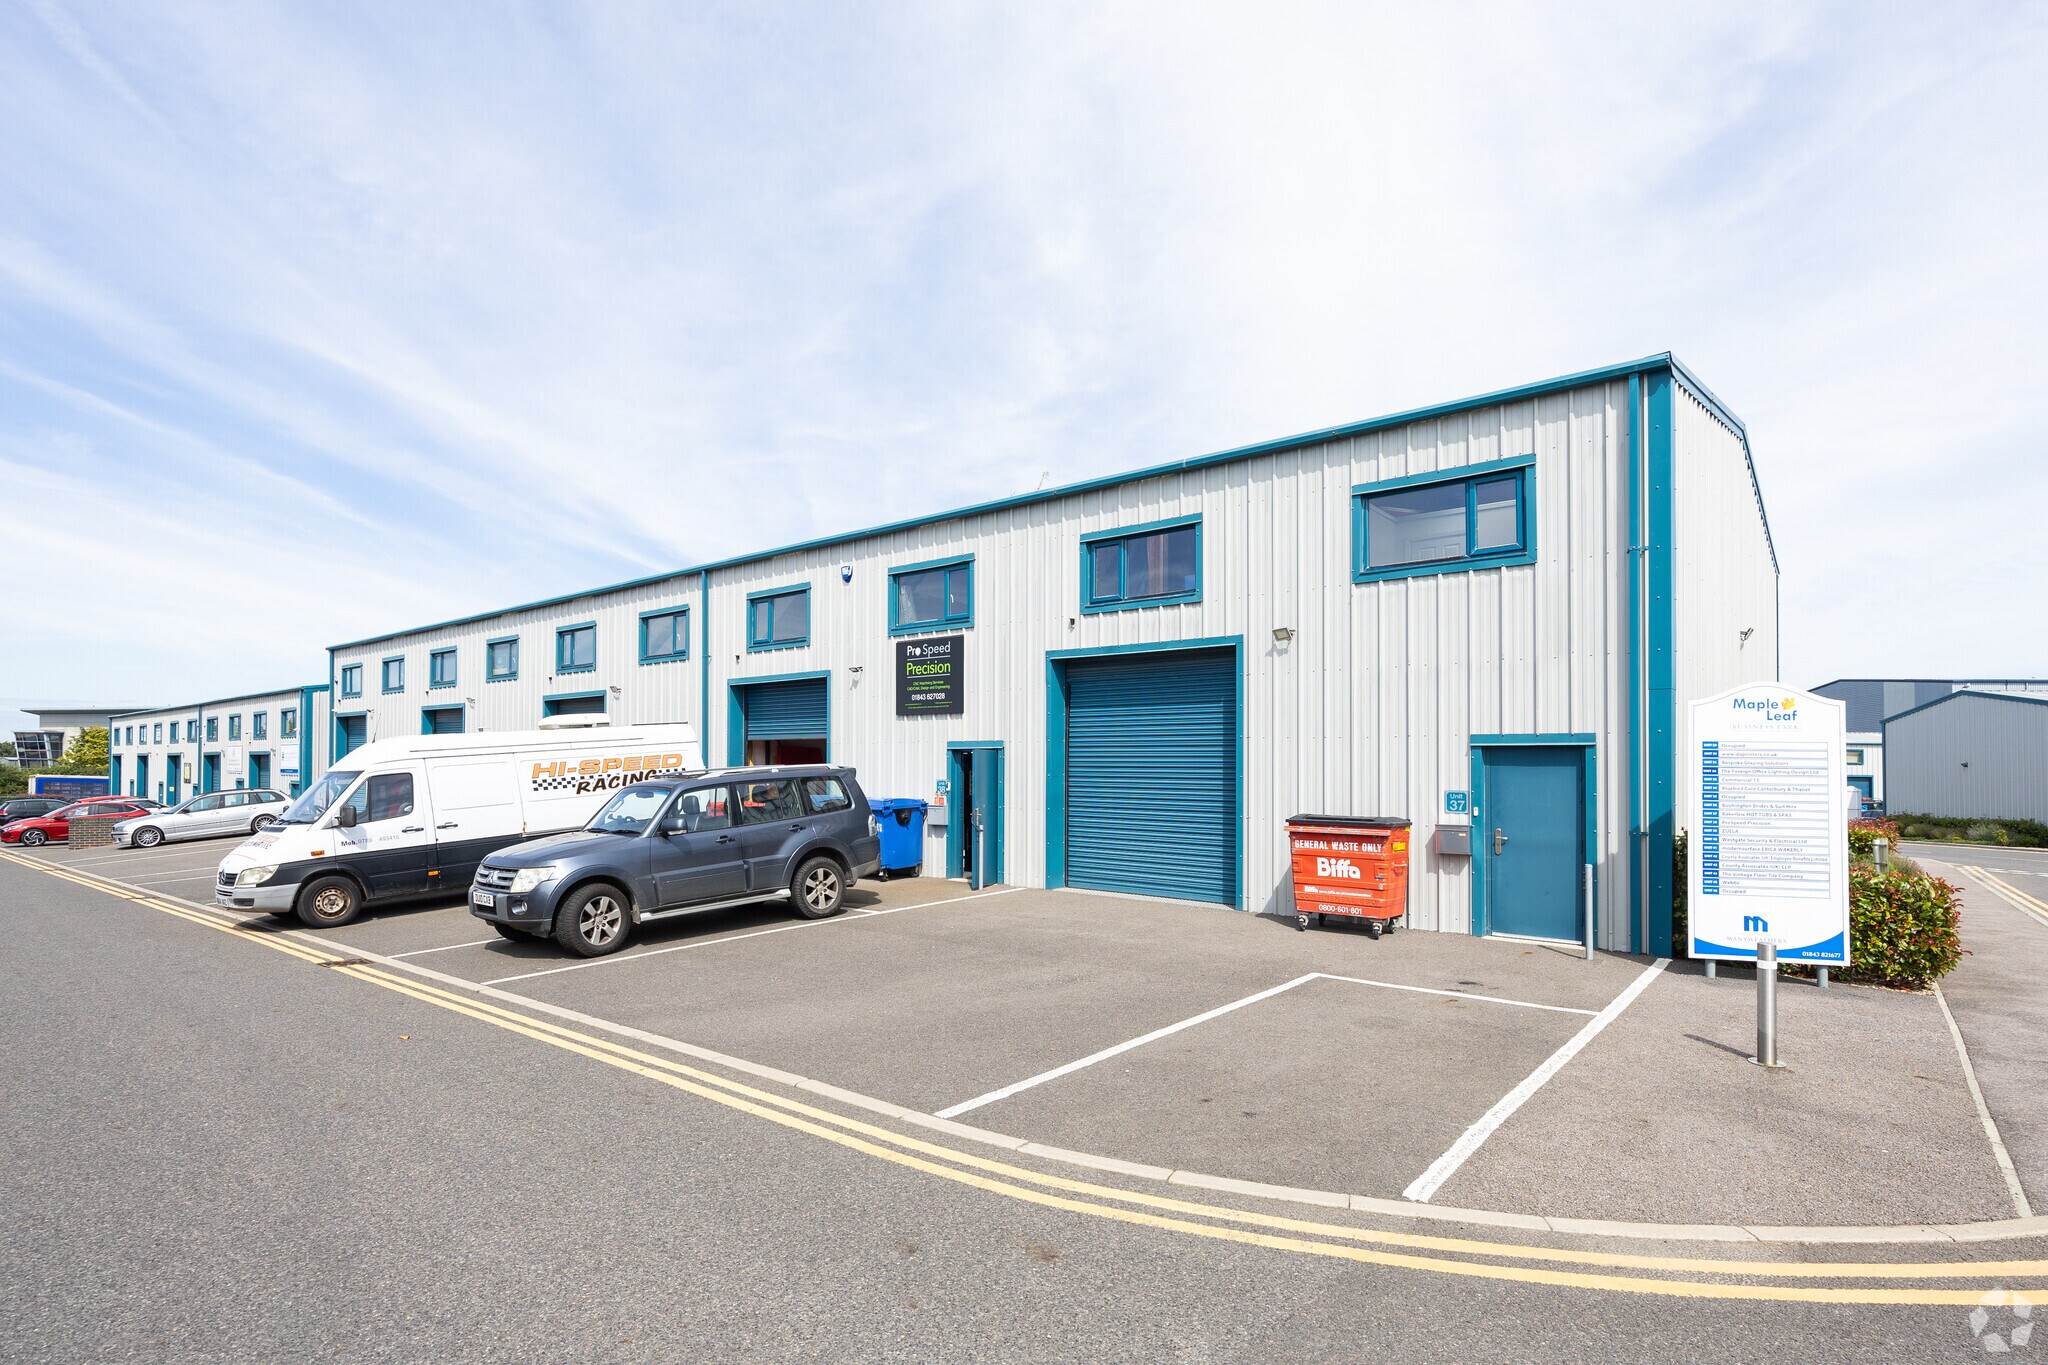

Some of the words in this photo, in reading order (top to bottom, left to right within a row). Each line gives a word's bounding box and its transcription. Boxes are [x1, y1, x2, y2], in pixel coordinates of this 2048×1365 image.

[907, 646, 921, 656] Pro
[922, 641, 950, 658] Speed
[907, 660, 950, 675] Precision
[1733, 698, 1778, 711] Maple
[1767, 710, 1797, 720] Leaf
[532, 754, 682, 778] HI-SPEED
[576, 770, 657, 794] RACING
[938, 786, 946, 794] 38
[1450, 800, 1465, 810] 37
[1294, 840, 1328, 850] GENERAL
[1332, 842, 1358, 852] WASTE
[1362, 843, 1382, 852] ONLY
[1317, 857, 1360, 879] Biffa
